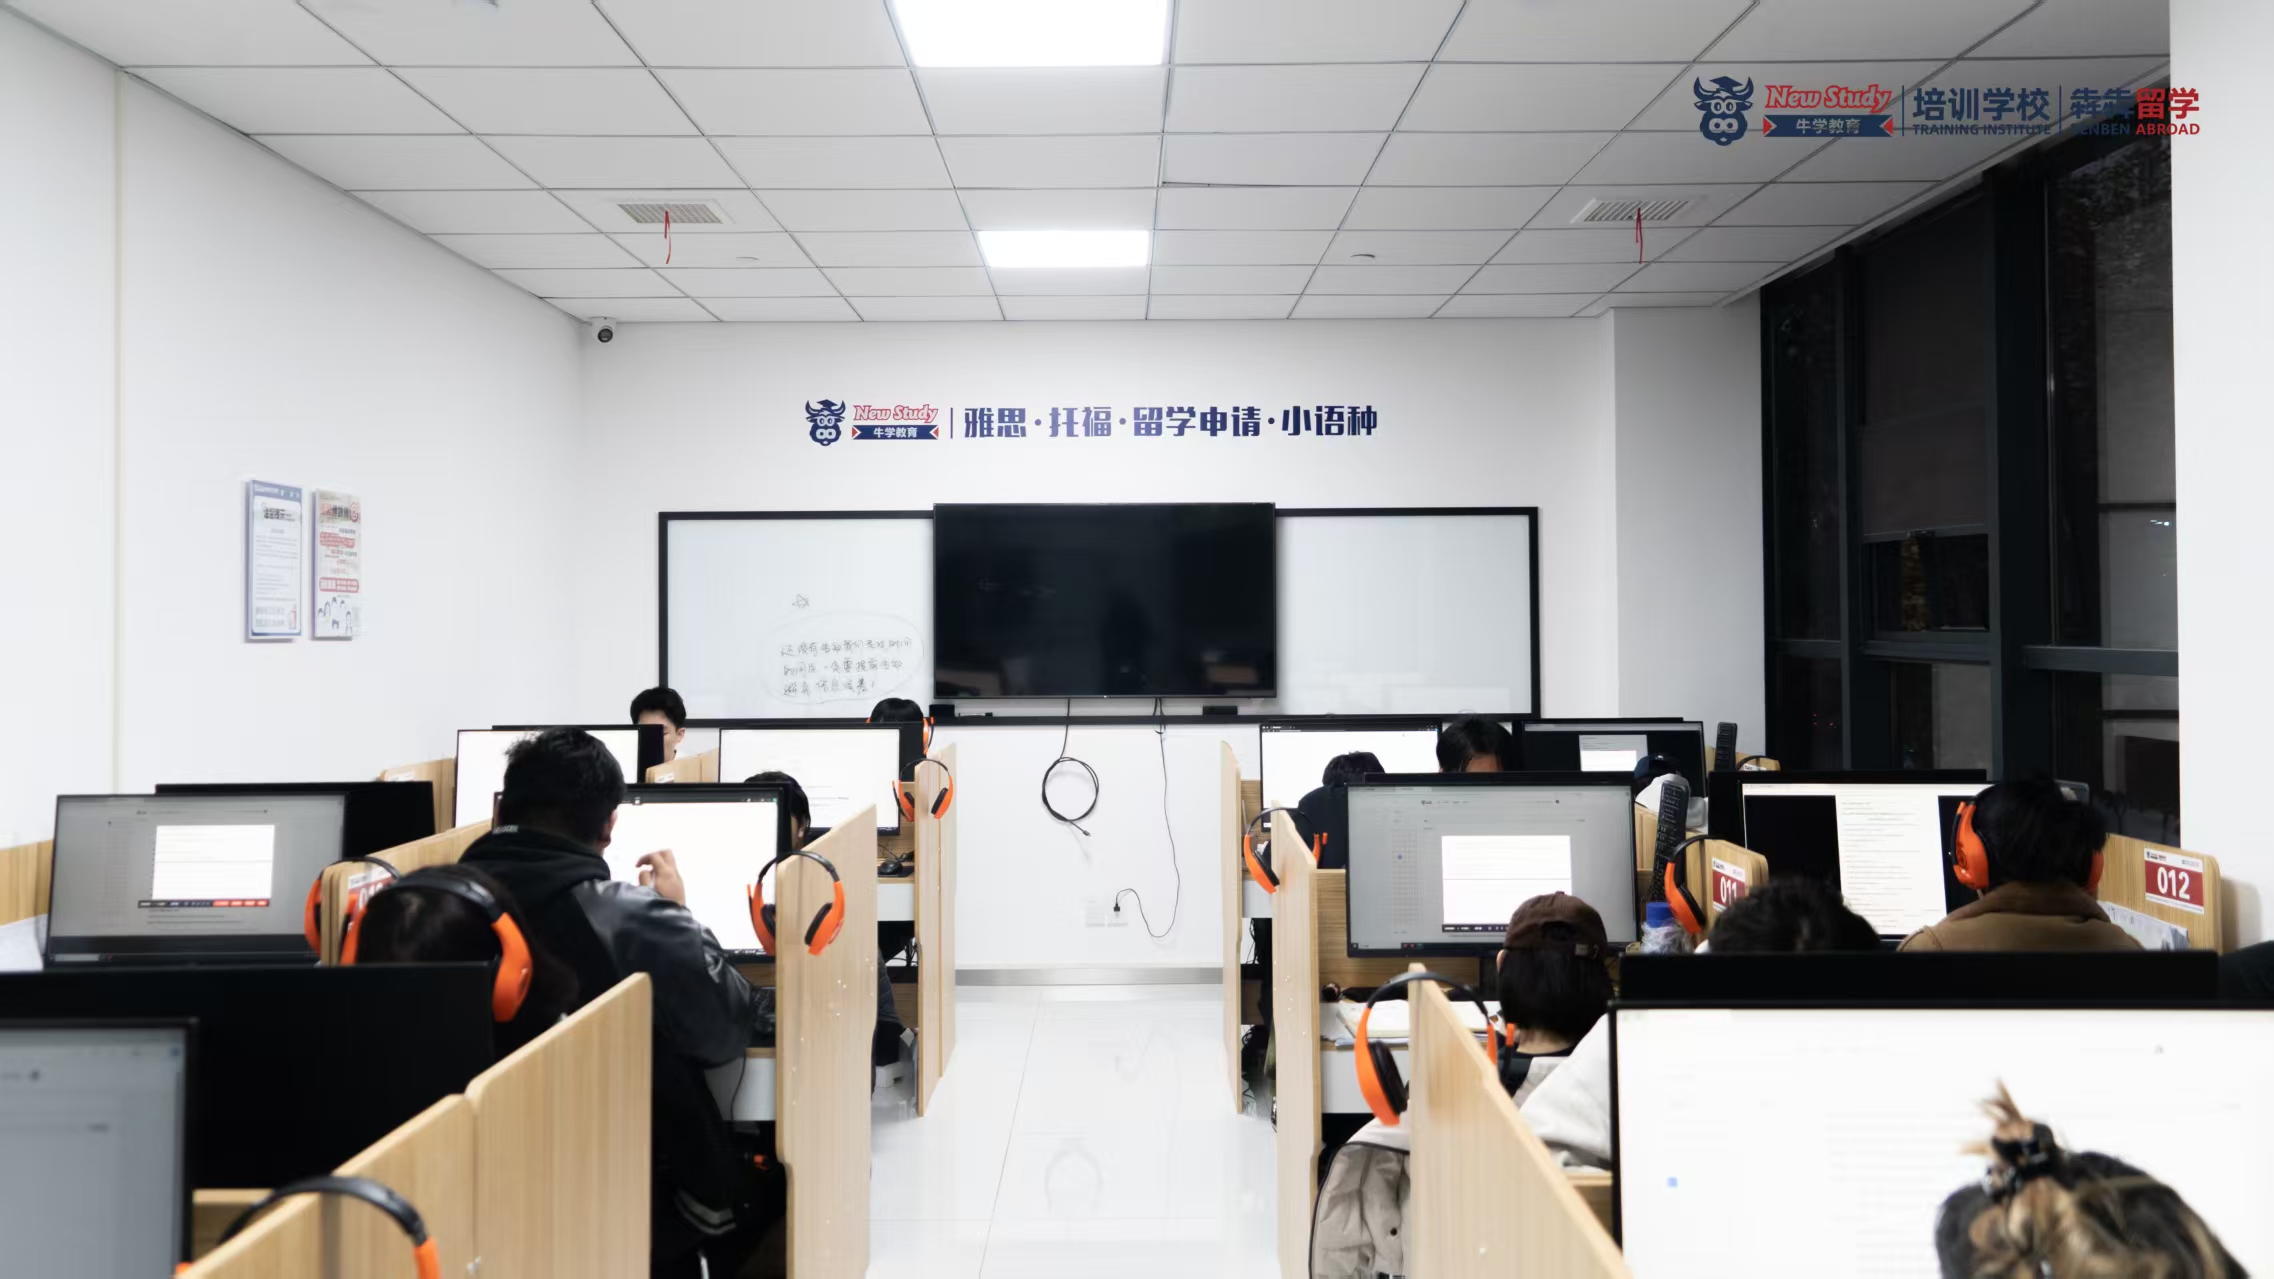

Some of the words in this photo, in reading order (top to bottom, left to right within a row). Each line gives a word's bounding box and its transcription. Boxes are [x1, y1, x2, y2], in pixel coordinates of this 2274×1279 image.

[852, 405, 890, 421] New
[890, 405, 939, 424] Study
[872, 426, 918, 439] 牛学教育
[2157, 866, 2190, 900] 012
